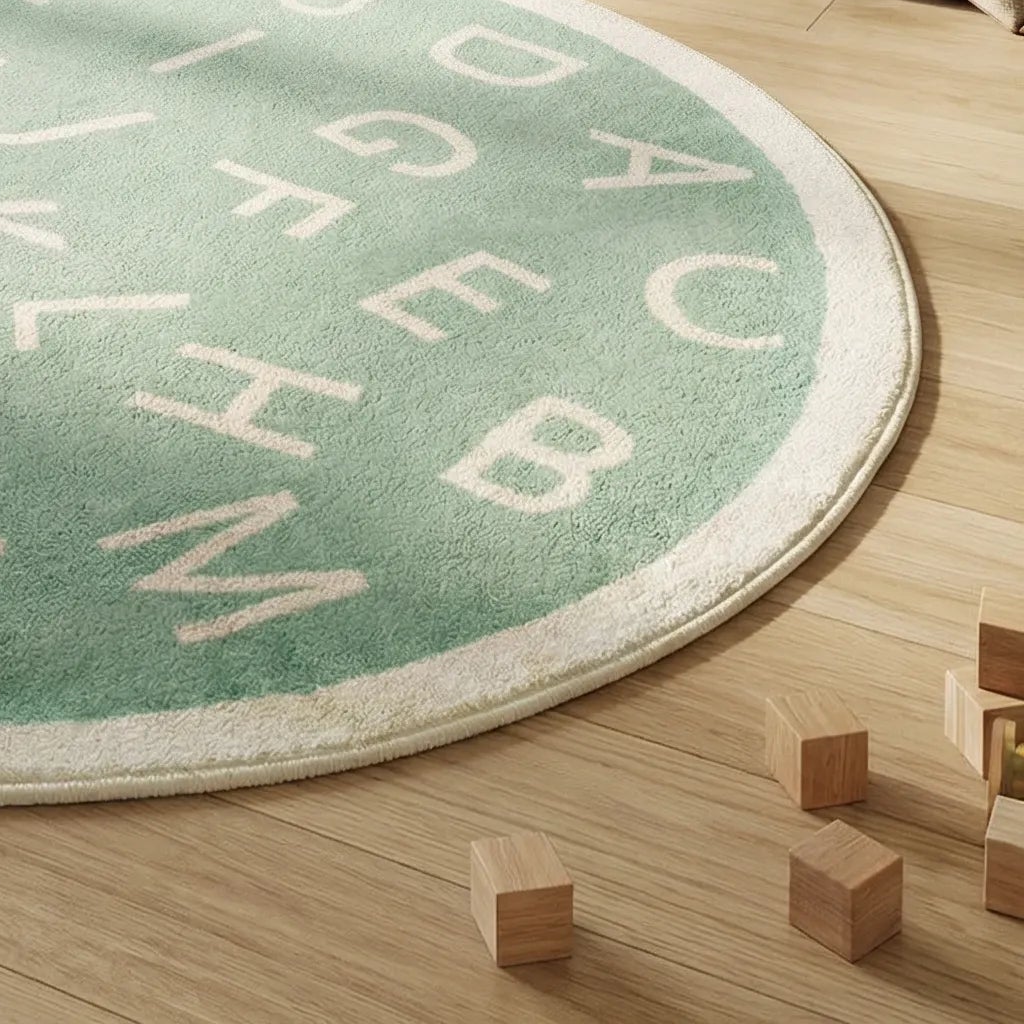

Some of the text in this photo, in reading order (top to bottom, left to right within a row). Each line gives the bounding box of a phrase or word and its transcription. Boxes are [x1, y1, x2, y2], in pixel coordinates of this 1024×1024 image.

[429, 24, 589, 88] D
[314, 109, 477, 179] G
[583, 129, 753, 191] A
[214, 159, 356, 240] F
[12, 292, 190, 352] L
[359, 251, 551, 342] E
[644, 252, 783, 350] C
[131, 343, 363, 459] H
[442, 396, 635, 516] B
[99, 489, 369, 645] M
